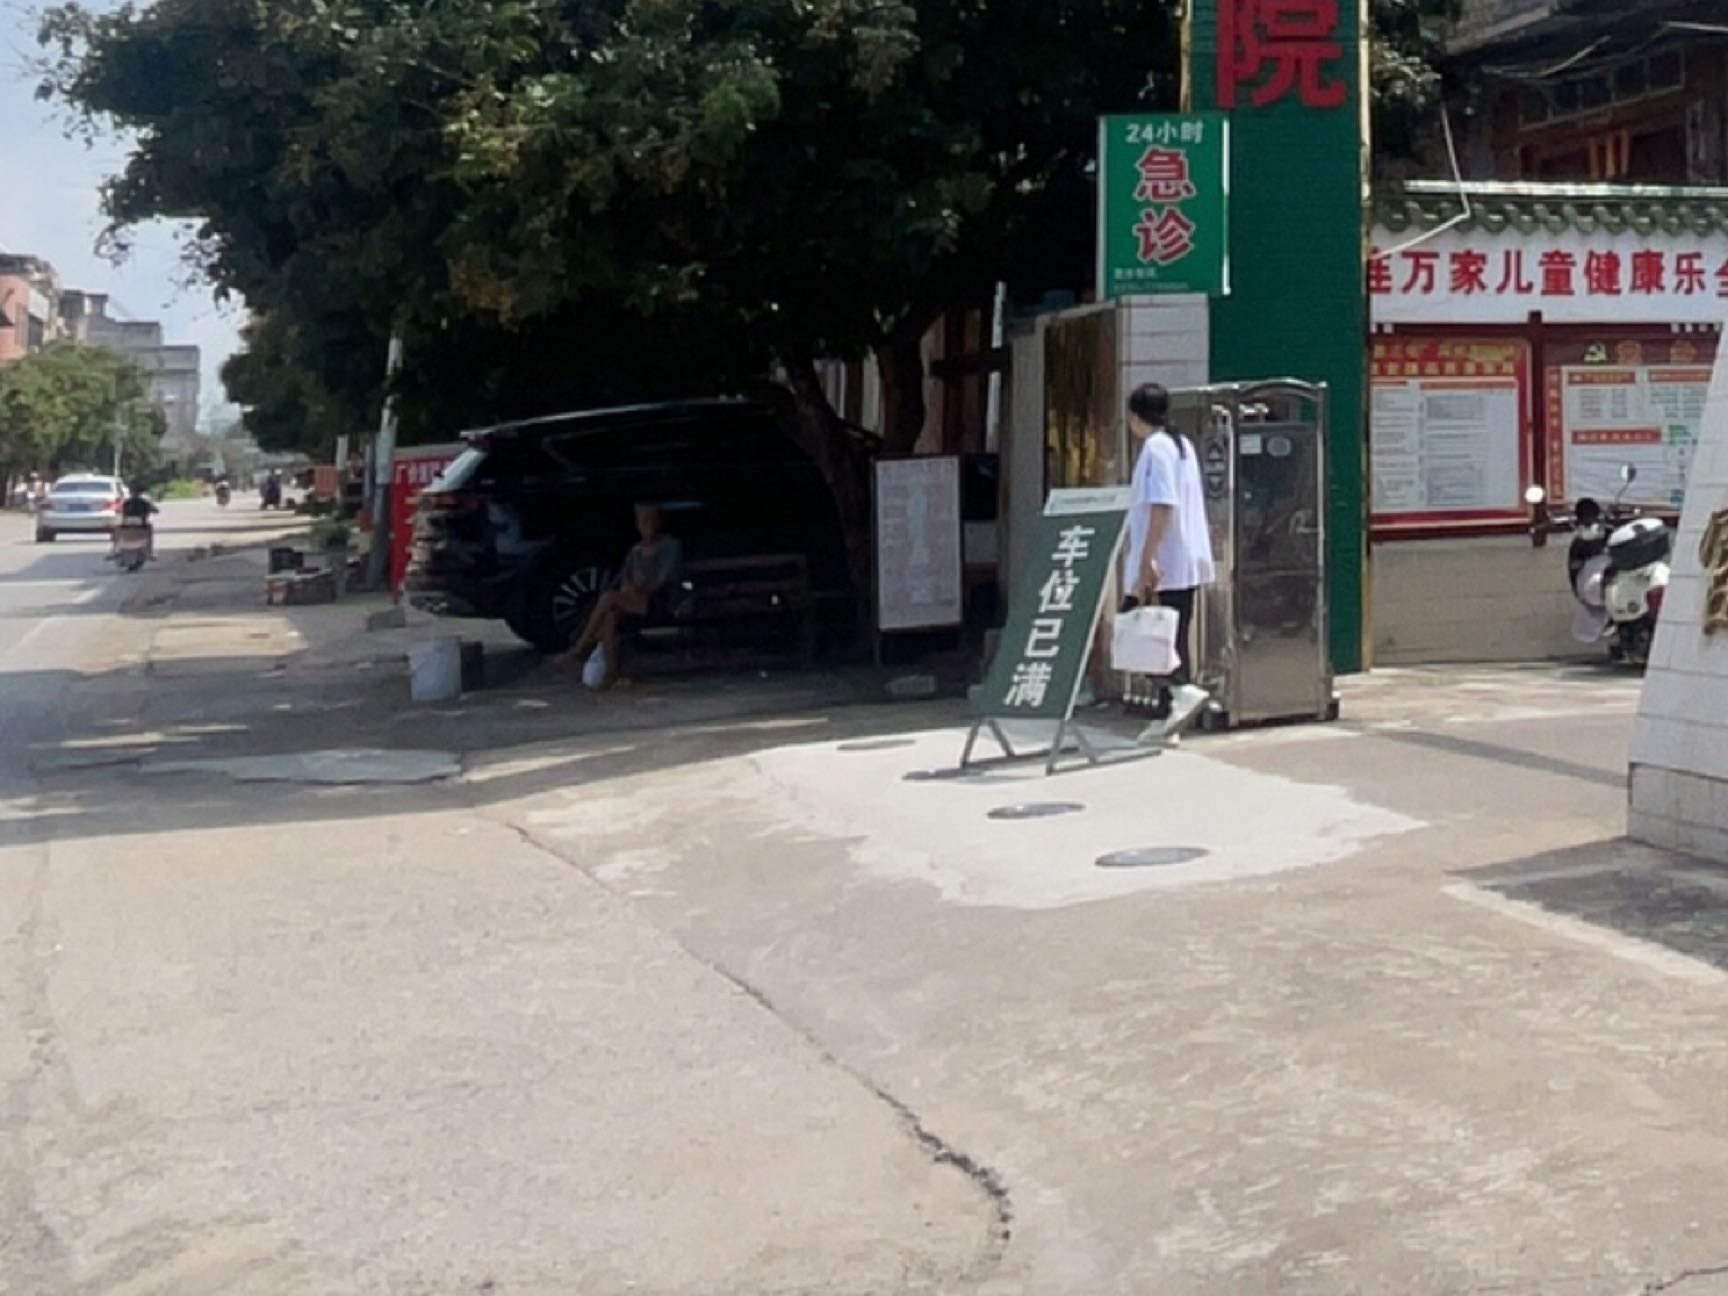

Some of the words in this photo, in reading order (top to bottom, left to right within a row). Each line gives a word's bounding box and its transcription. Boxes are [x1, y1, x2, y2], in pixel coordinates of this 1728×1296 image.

[1125, 120, 1203, 144] 24小时
[1132, 144, 1196, 265] 急诊
[1003, 525, 1095, 708] 车位已满
